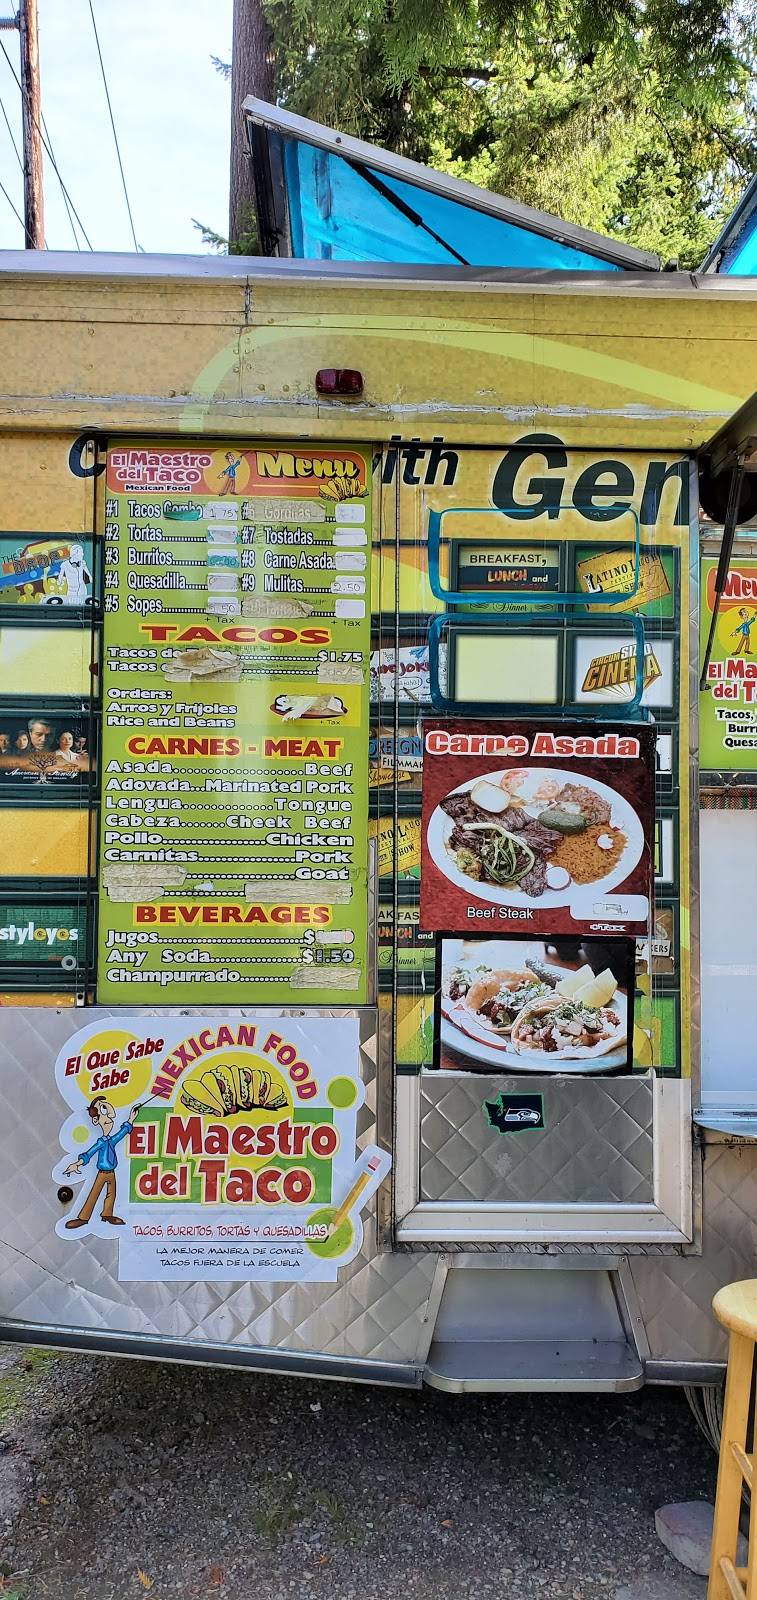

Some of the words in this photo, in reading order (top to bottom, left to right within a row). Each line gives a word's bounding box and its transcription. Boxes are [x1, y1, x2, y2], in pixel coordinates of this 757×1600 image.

[112, 454, 127, 466] El
[130, 451, 211, 467] Maestro
[255, 451, 360, 478] Menu
[117, 467, 141, 480] del
[145, 466, 202, 483] Taco
[125, 484, 165, 492] Mexican
[166, 484, 191, 492] Food
[105, 501, 119, 518] #1
[128, 501, 160, 518] Tacos
[106, 524, 120, 542] #2
[128, 525, 162, 542] Tortas
[241, 526, 255, 544] #7
[265, 526, 314, 545] Tostadas
[105, 550, 119, 565] #3
[128, 550, 173, 566] Burritos
[241, 550, 255, 568] #8
[264, 550, 297, 569] Carne
[298, 550, 334, 569] Asada
[470, 554, 547, 567] BREAKFAST,
[105, 572, 119, 588] #4
[127, 571, 187, 590] Quesadilla
[241, 573, 255, 592] #9
[264, 573, 304, 592] Mulitas
[487, 569, 528, 583] LUNCH
[532, 574, 548, 583] and
[105, 595, 119, 611] #5
[127, 596, 162, 616] Sopes
[343, 619, 361, 627] Tax
[141, 625, 331, 644] TACOS
[107, 647, 157, 658] Tacos
[317, 650, 363, 663] $1.75
[107, 661, 157, 672] Tacos
[709, 663, 722, 679] El
[107, 688, 172, 700] Orders:
[713, 683, 738, 698] del
[106, 702, 158, 713] Arros
[161, 704, 173, 717] y
[175, 703, 238, 717] Frijoles
[716, 709, 754, 721] Tacos,
[106, 715, 145, 727] Rice
[148, 716, 180, 727] and
[184, 716, 236, 728] Beans
[128, 737, 240, 756] CARNES
[265, 739, 342, 758] MEAT
[426, 731, 529, 757] Carne
[530, 732, 640, 759] Asada
[106, 760, 173, 775] Asada
[304, 763, 354, 777] Beef
[105, 778, 191, 792] Adovada
[205, 778, 301, 794] Marinated
[305, 780, 354, 795] Pork
[105, 796, 182, 814] Lengua
[273, 797, 353, 815] Tongue
[105, 813, 182, 829] Cabeza
[226, 814, 291, 830] Cheek
[303, 815, 353, 831] Beef
[104, 831, 163, 845] Pollo
[265, 832, 354, 847] Chicken
[104, 848, 200, 862] Carnitas
[294, 850, 353, 864] Pork
[295, 867, 349, 881] Goat
[136, 906, 331, 924] BEVERAGES
[466, 906, 496, 919] Beef
[498, 907, 534, 920] Steak
[105, 929, 158, 947] Jugos
[417, 931, 434, 940] and
[106, 949, 147, 968] Any
[160, 949, 211, 964] Soda
[106, 968, 241, 986] Champurrado
[64, 1056, 82, 1077] El
[86, 1047, 120, 1071] Que
[126, 1036, 165, 1061] Sabe
[150, 1025, 257, 1100] MEXICAN
[262, 1033, 318, 1100] FOOD
[91, 1069, 130, 1092] Sabe
[129, 1125, 156, 1156] El
[166, 1116, 338, 1156] Maestro
[138, 1164, 188, 1197] del
[198, 1159, 314, 1205] Taco
[133, 1225, 164, 1238] TACOS,
[167, 1225, 214, 1238] BURRITOS,
[217, 1225, 250, 1237] TORTAS
[263, 1225, 327, 1238] QUESADILLAS
[171, 1247, 205, 1255] MEJOR
[208, 1247, 250, 1255] MANERA
[253, 1247, 267, 1255] DE
[269, 1247, 304, 1256] COMER
[160, 1259, 191, 1267] TACOS
[193, 1259, 224, 1267] FUERA
[226, 1259, 241, 1267] DE
[244, 1259, 256, 1267] LA
[258, 1259, 301, 1267] ESCUELA
